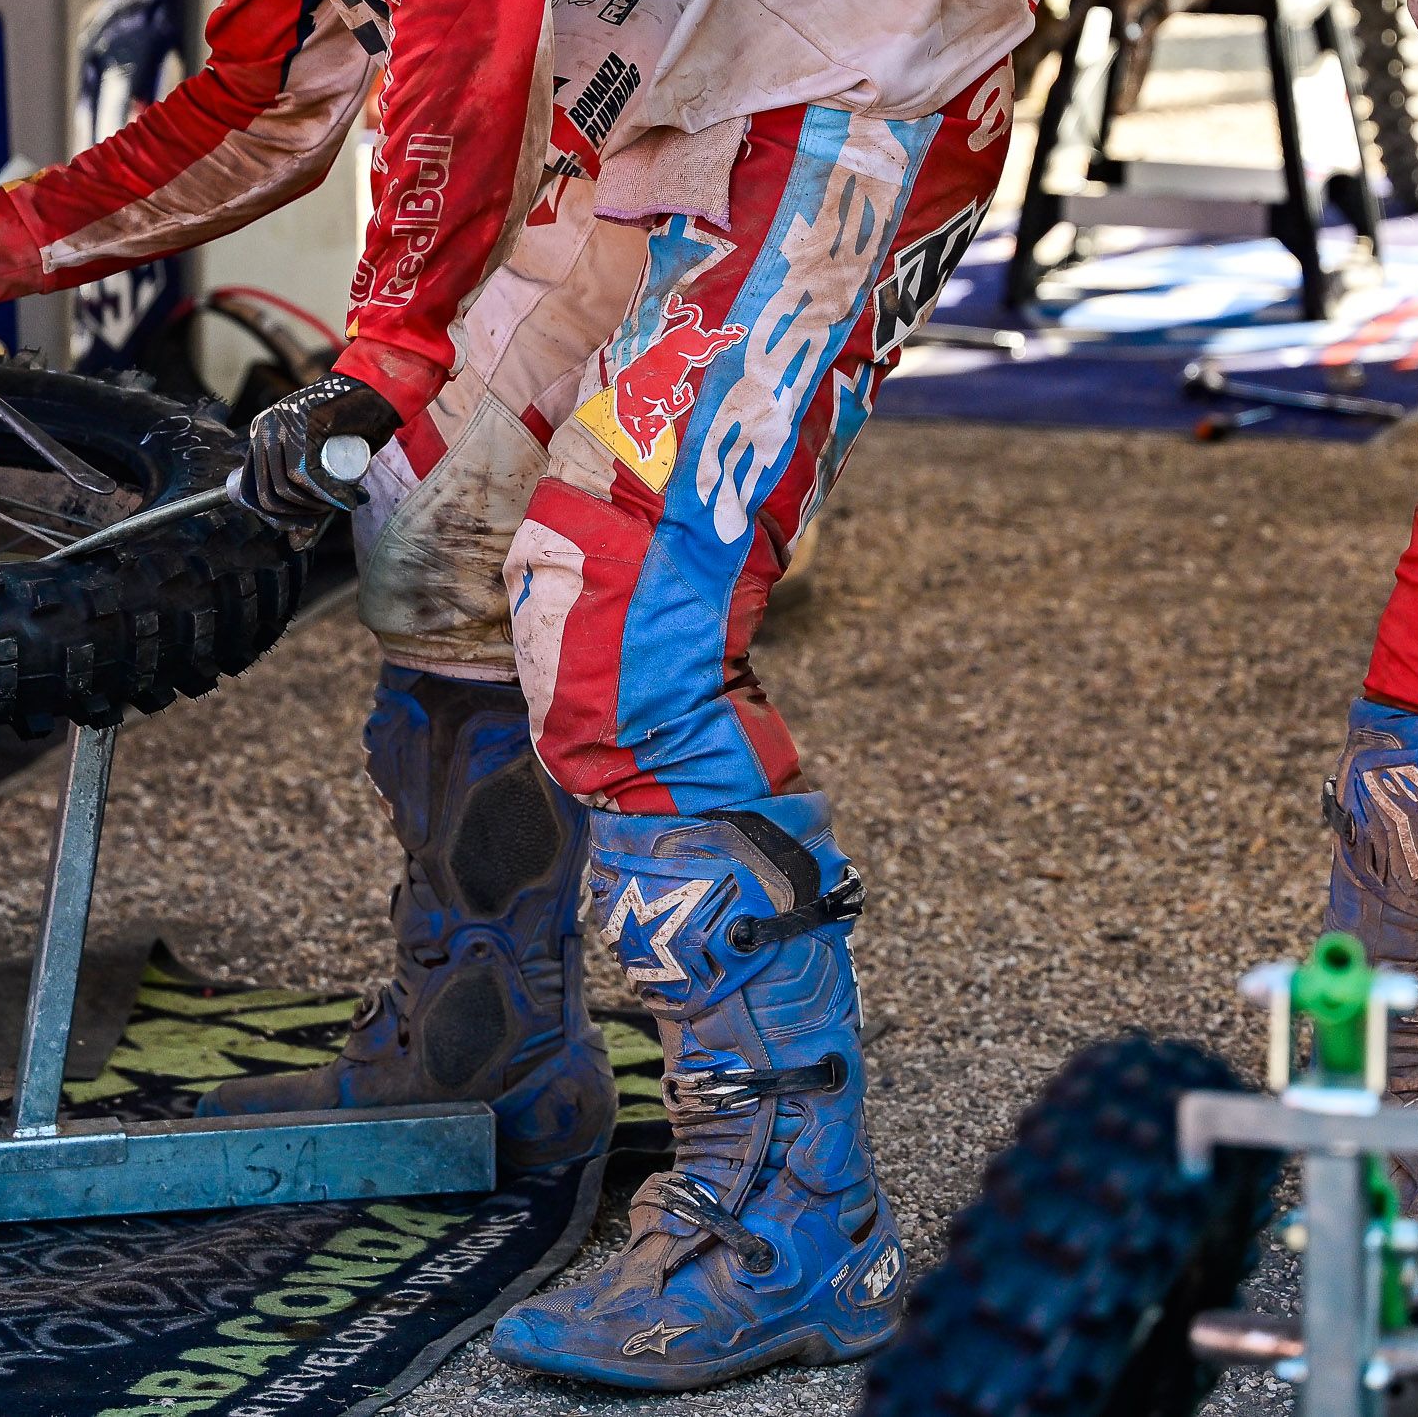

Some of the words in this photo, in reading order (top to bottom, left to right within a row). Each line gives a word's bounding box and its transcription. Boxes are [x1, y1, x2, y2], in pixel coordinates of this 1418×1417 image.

[568, 50, 627, 131] BONANZA
[584, 62, 642, 150] PLUMBING
[395, 132, 454, 224] Bull
